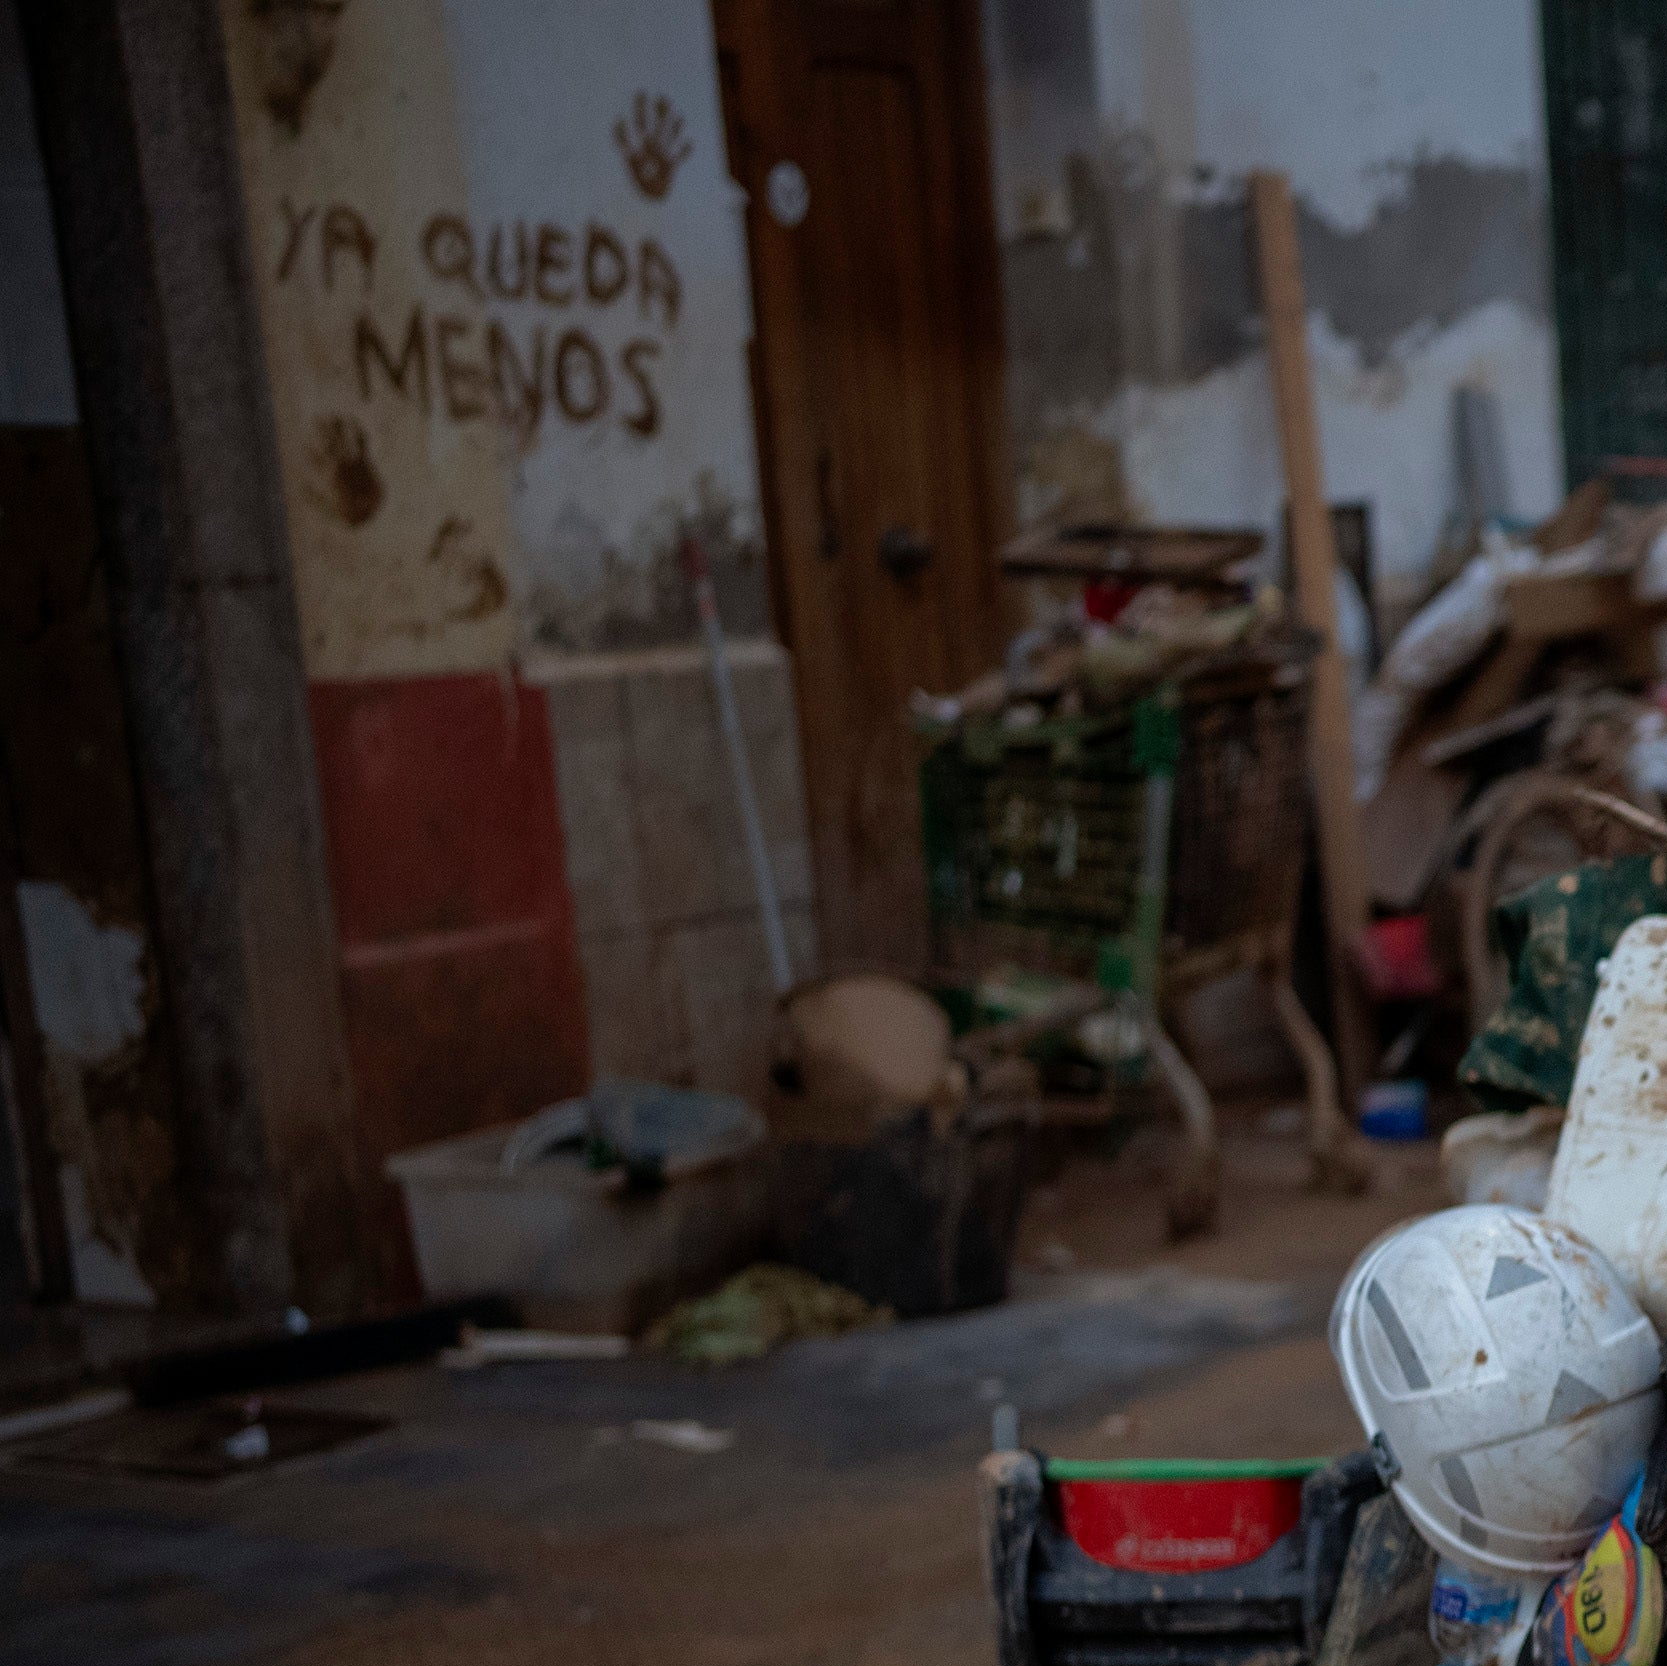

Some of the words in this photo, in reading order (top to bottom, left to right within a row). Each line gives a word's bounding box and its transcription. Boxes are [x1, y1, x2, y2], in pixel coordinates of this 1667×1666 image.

[276, 194, 378, 293] YA
[420, 209, 686, 332] QUEDA
[351, 304, 665, 444] MENOS
